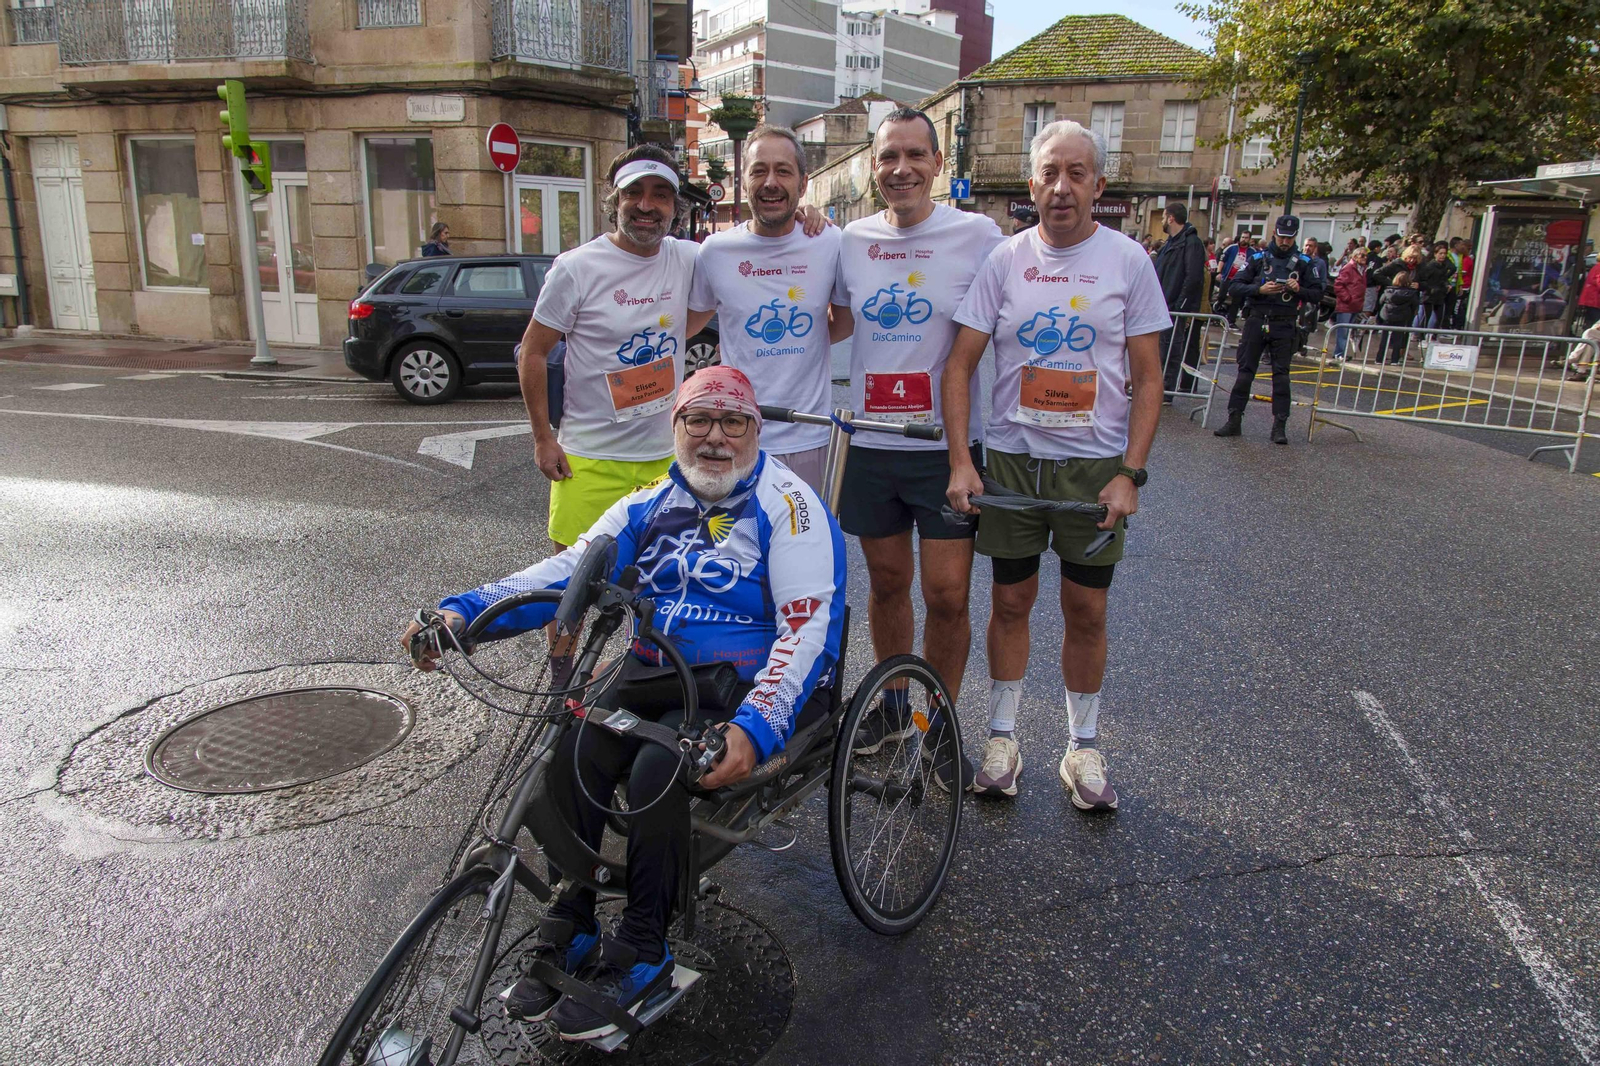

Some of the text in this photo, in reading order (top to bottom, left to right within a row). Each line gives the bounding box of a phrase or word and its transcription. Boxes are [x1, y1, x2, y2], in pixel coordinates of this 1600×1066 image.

[711, 189, 721, 197] 30
[1010, 201, 1126, 213] DROGU RFUMERÍA
[878, 251, 906, 260] ribera
[752, 268, 782, 277] ribera
[1036, 275, 1069, 283] ribera
[627, 297, 654, 306] ribera
[872, 332, 922, 342] DisCamino
[756, 346, 805, 357] DisCamino
[635, 381, 657, 392] Eliseo
[892, 380, 906, 398] 4
[1045, 389, 1069, 398] Silvia
[1034, 398, 1045, 406] Rey
[792, 490, 810, 533] RODOSA
[656, 599, 753, 624] amino
[713, 646, 766, 660] Hospital
